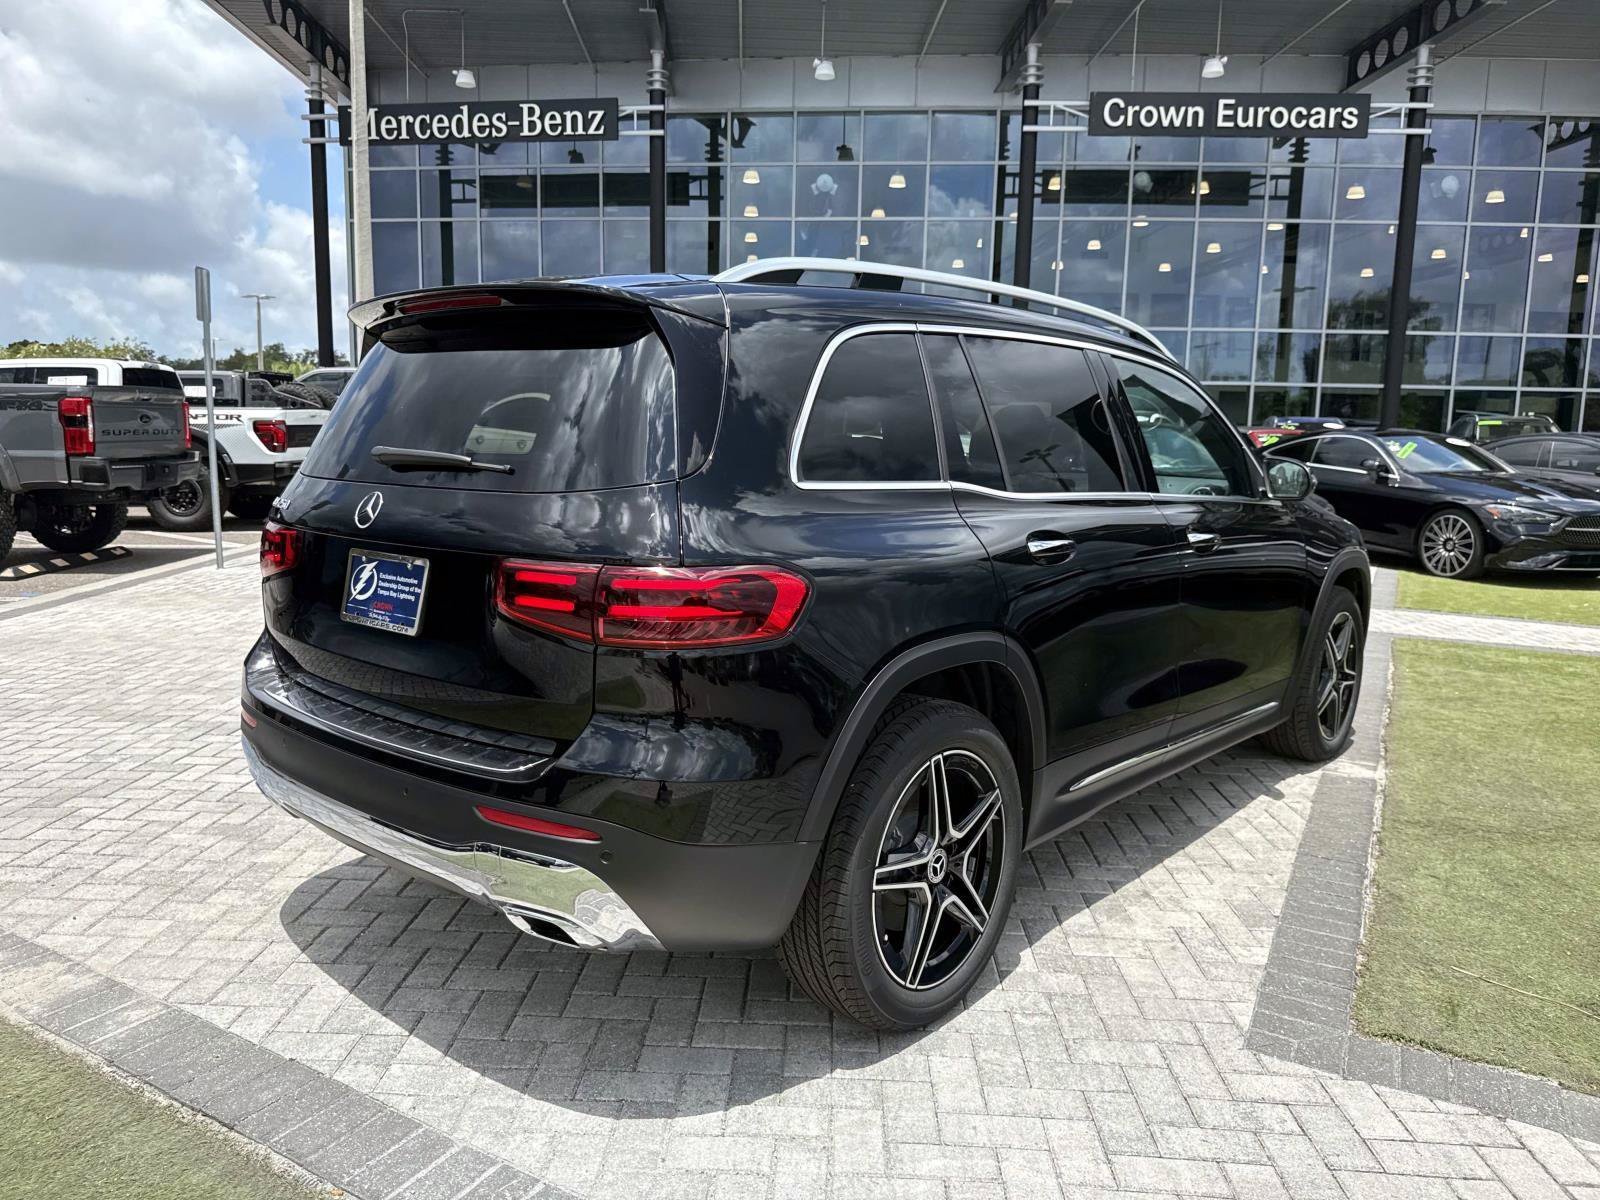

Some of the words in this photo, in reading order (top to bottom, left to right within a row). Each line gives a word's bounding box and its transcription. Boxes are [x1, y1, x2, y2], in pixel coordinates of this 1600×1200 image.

[1103, 97, 1204, 128] Crown
[1216, 98, 1359, 130] Eurocars
[347, 102, 605, 140] Mercedes-Benz
[188, 413, 244, 423] APOR
[152, 428, 181, 436] DUTY
[397, 576, 418, 584] Automotive
[379, 581, 397, 589] Dealership
[398, 583, 409, 591] Group
[397, 592, 415, 601] Lightning
